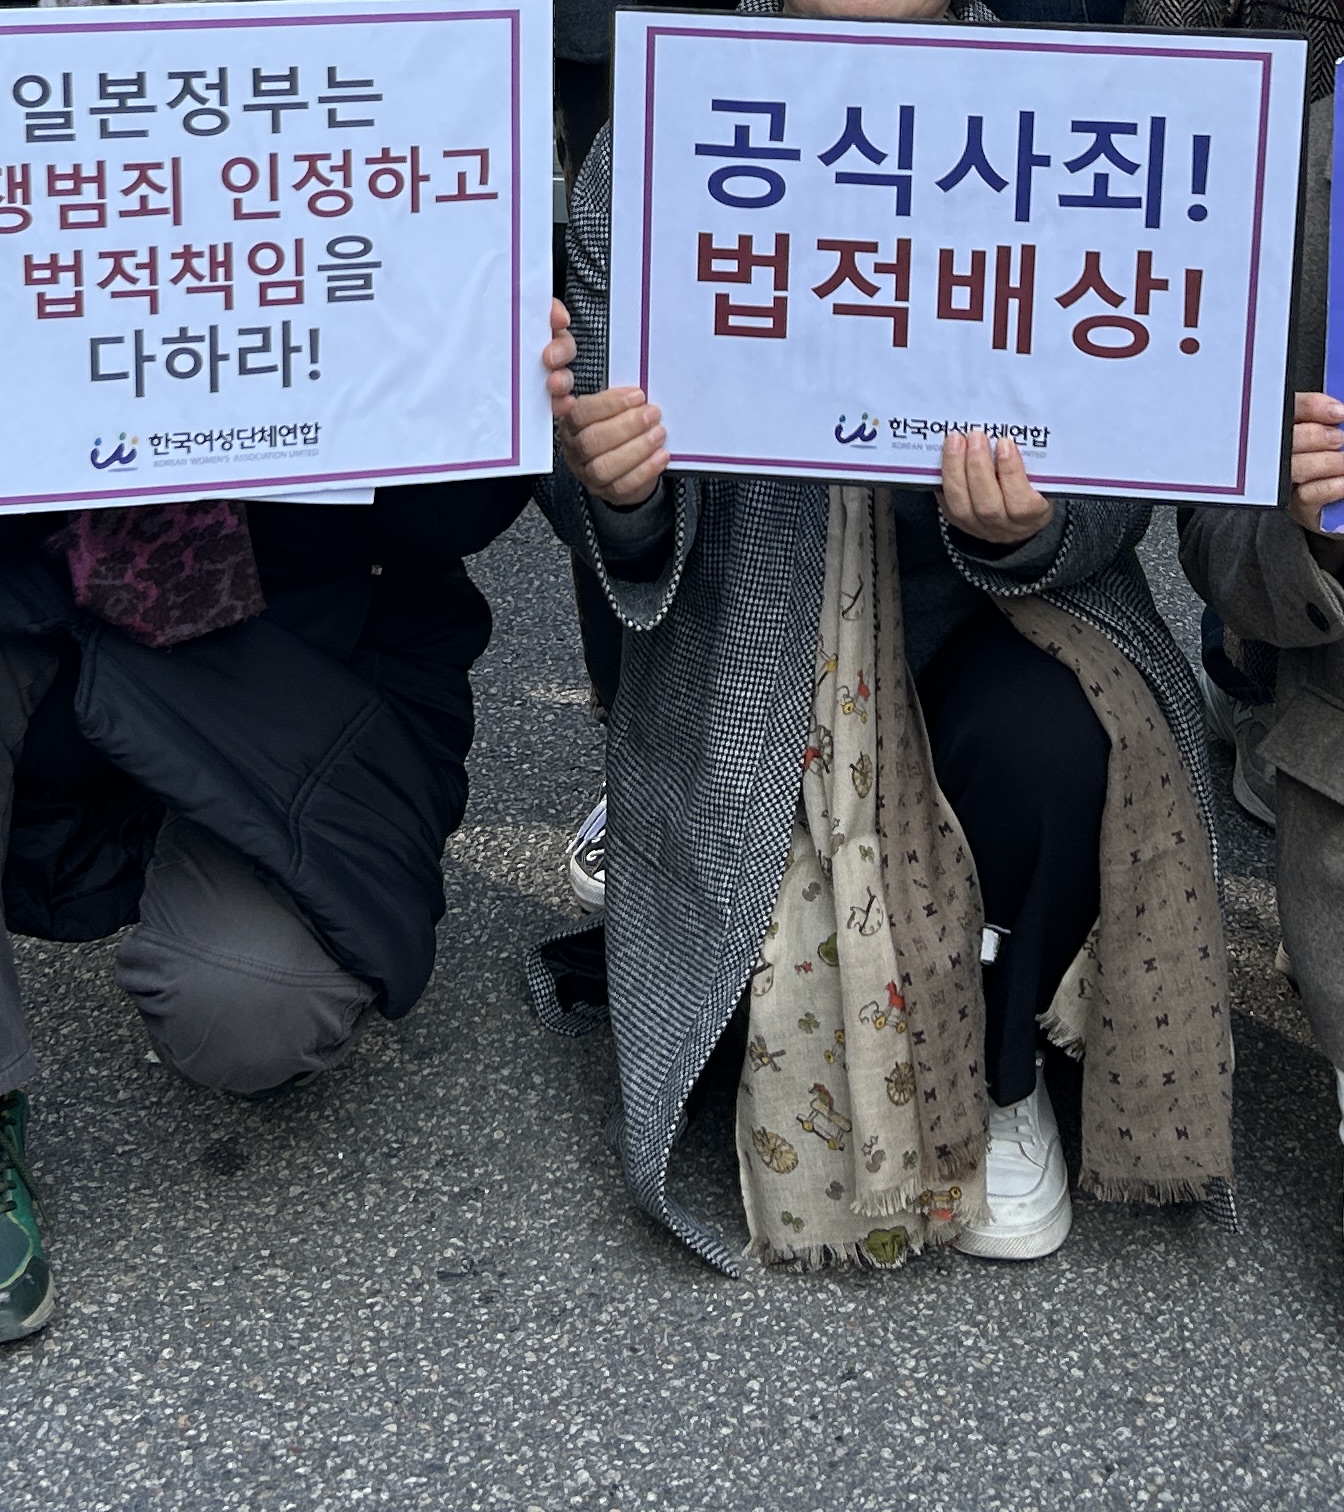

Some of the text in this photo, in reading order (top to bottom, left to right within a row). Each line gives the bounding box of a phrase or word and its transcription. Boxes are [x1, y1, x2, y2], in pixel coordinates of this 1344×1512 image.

[12, 65, 383, 144] 일본정부는
[221, 146, 499, 221] 인정하고
[694, 98, 1212, 230] 공식사죄!
[23, 234, 383, 321] 법적책임을
[697, 232, 1203, 360] 법적배상!
[90, 320, 322, 399] 다하라!
[149, 422, 322, 456] 한국여성단체연합
